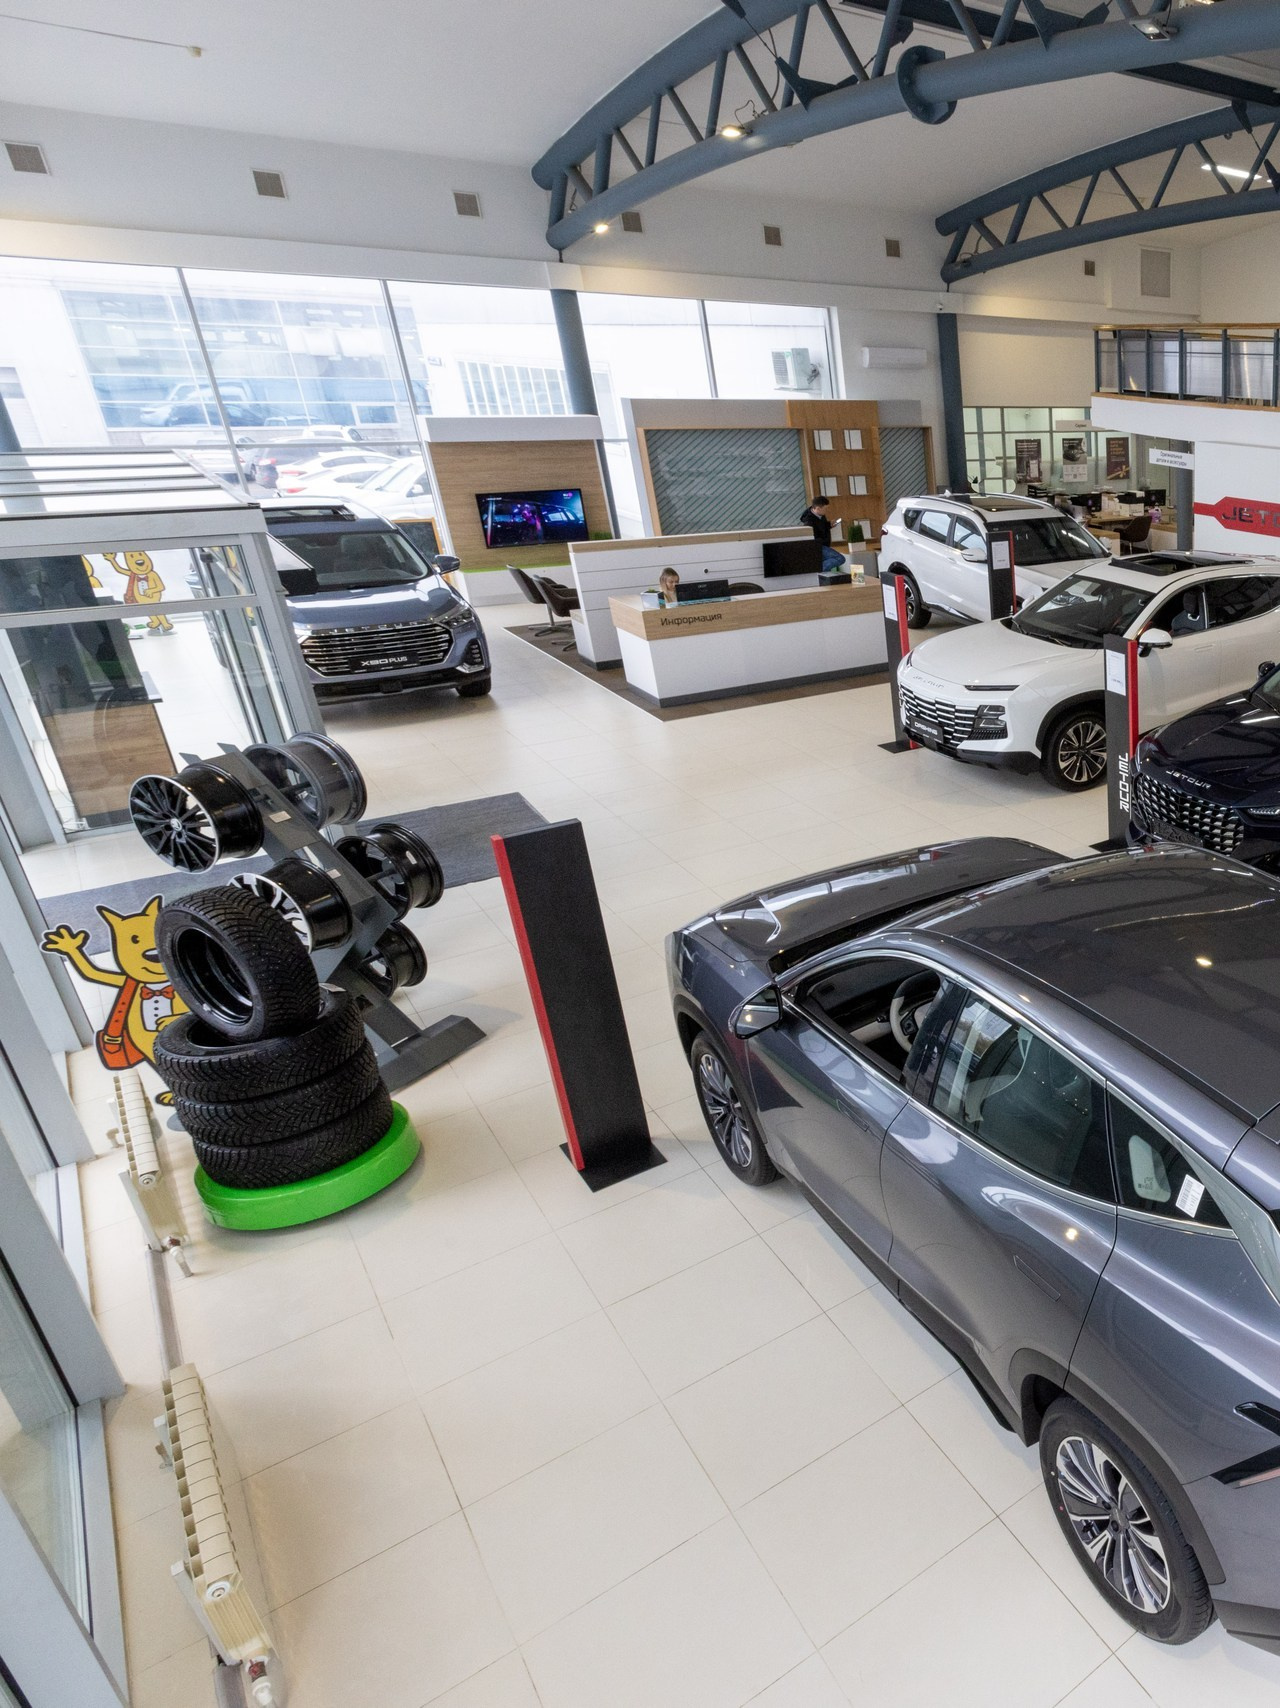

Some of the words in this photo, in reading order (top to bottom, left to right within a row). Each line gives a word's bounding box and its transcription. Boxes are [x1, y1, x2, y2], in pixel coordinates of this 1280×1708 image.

[660, 612, 723, 626] Информация
[1118, 752, 1130, 813] JETOUR
[1165, 769, 1212, 790] JETOUR
